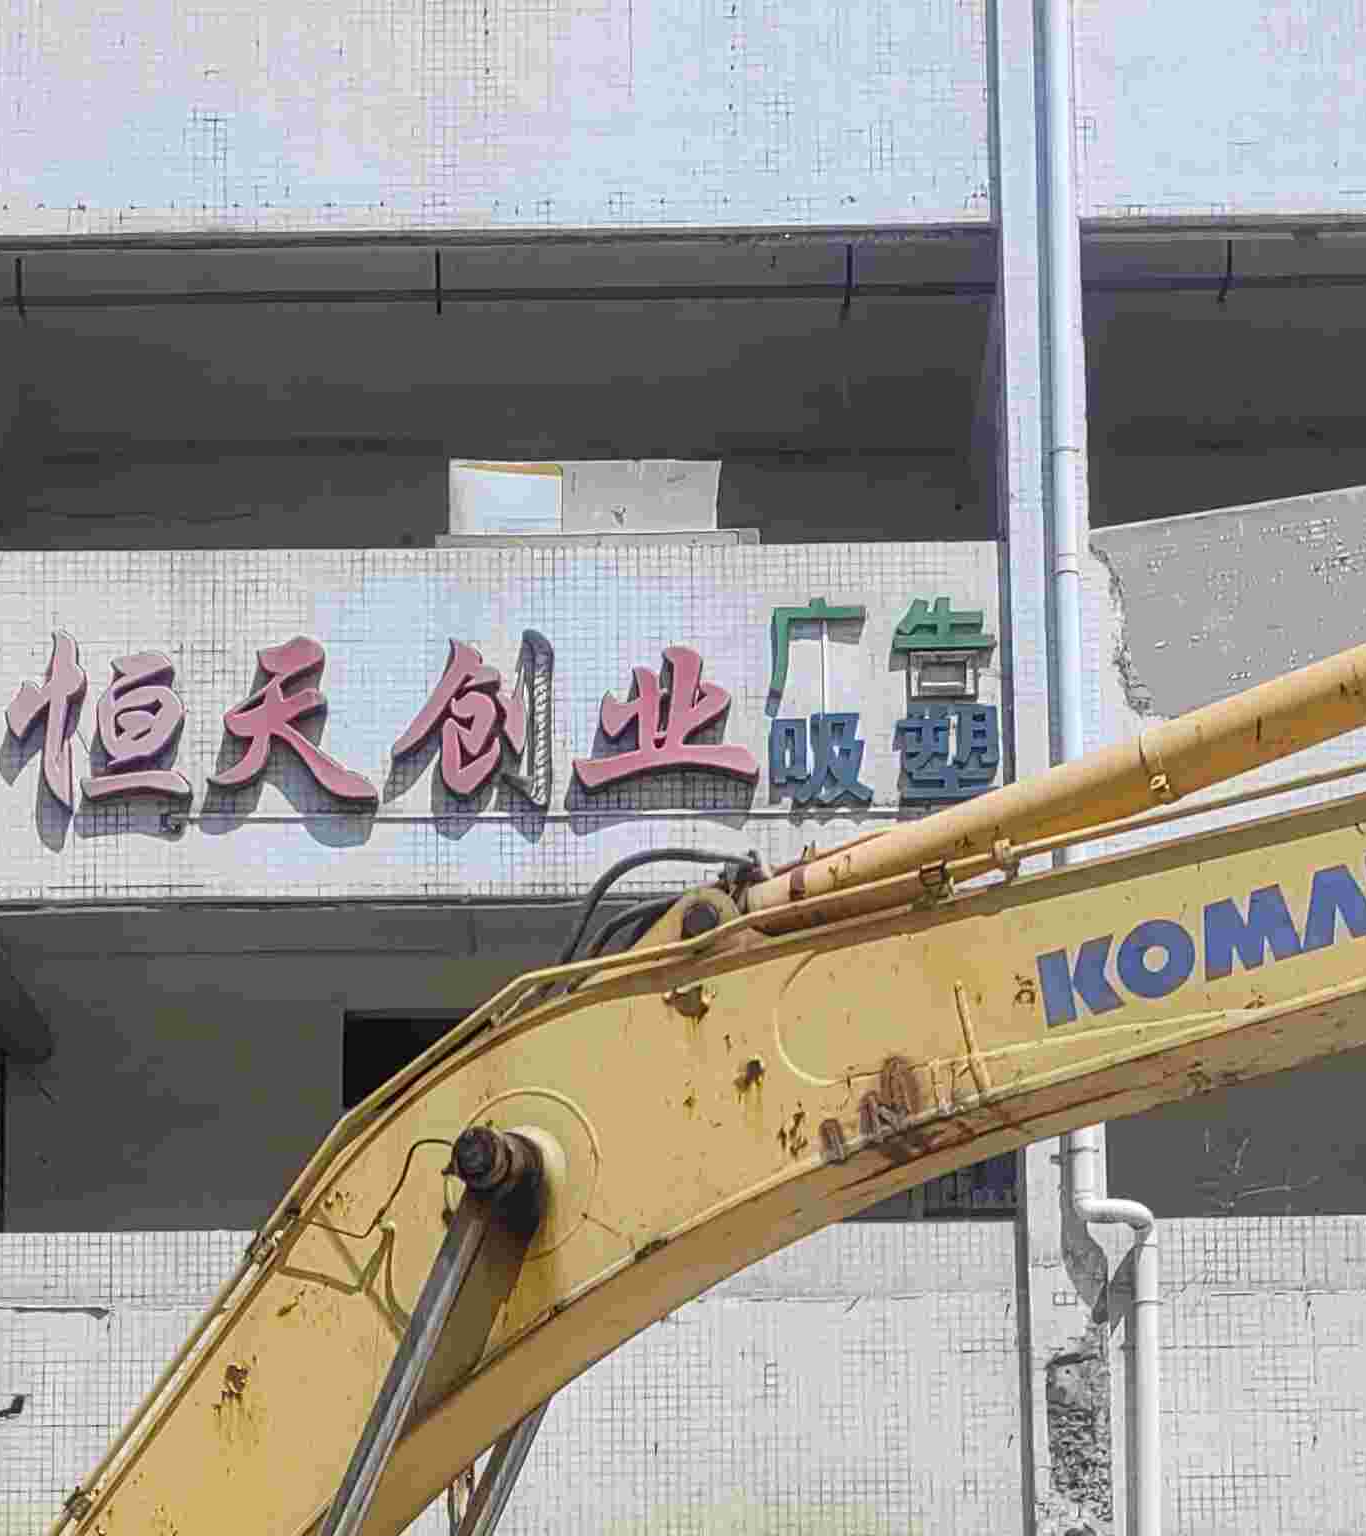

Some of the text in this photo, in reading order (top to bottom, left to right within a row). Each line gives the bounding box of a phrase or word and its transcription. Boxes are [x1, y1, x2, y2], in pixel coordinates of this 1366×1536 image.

[4, 628, 759, 808] 恒天创业
[764, 597, 997, 718] 广告
[767, 703, 998, 804] 吸塑
